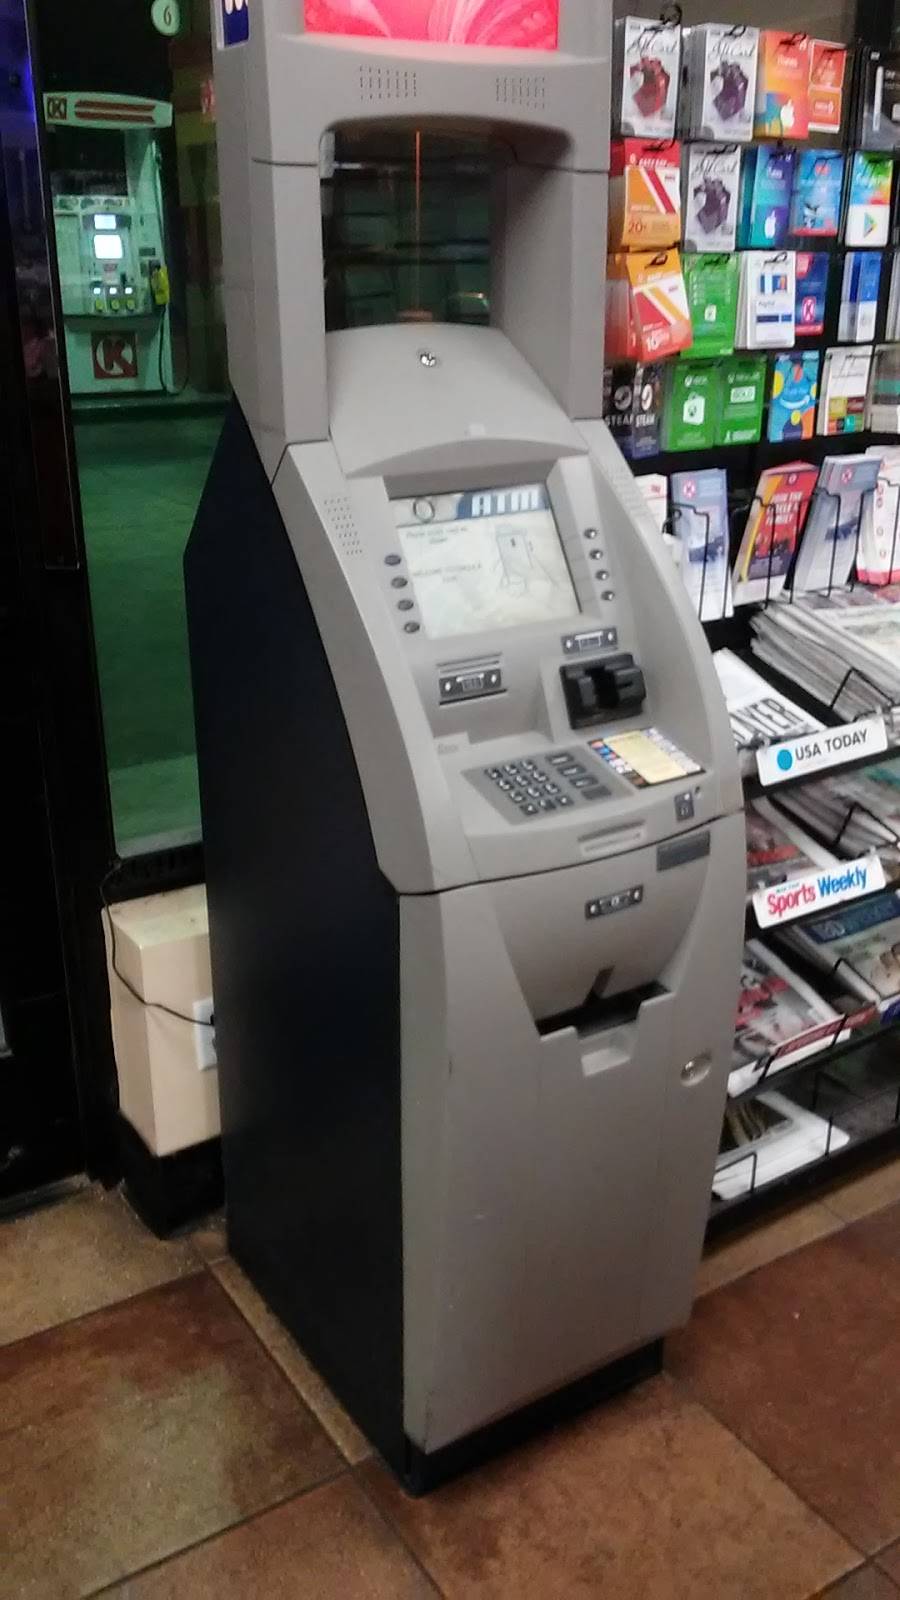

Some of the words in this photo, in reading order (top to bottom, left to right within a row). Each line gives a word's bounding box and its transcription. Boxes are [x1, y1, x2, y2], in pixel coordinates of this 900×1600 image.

[162, 7, 172, 26] 6
[471, 489, 540, 518] ATM
[795, 742, 821, 761] USA
[825, 728, 867, 753] TODAY
[767, 884, 816, 917] Sports
[817, 866, 867, 897] Weekly
